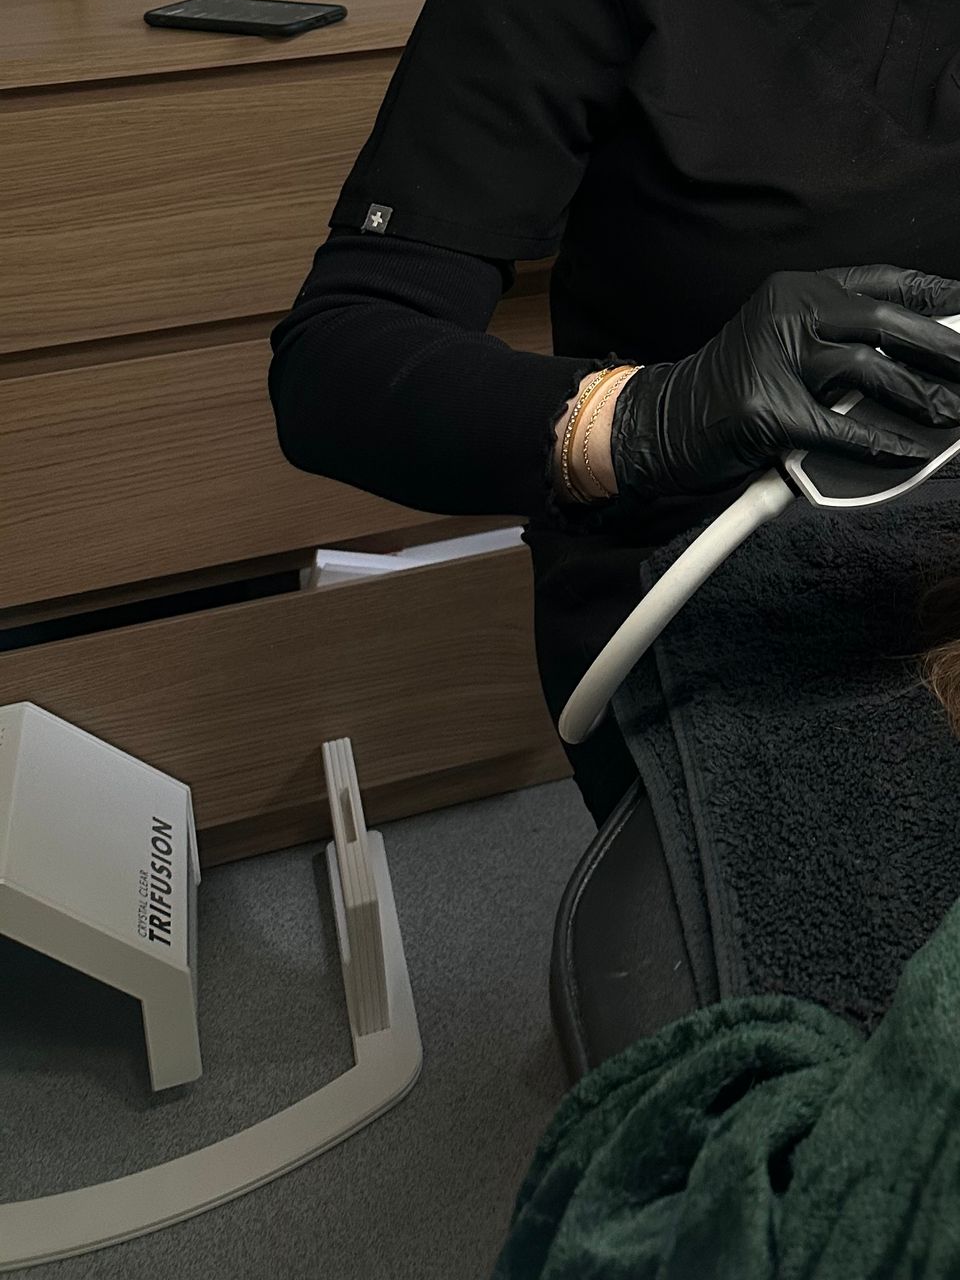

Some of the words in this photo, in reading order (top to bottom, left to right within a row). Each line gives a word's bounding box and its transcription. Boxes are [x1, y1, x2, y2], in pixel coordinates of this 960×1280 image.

[138, 869, 149, 897] CLEAR
[149, 816, 173, 947] TRIFUSION
[137, 901, 148, 938] CRYSTAL
